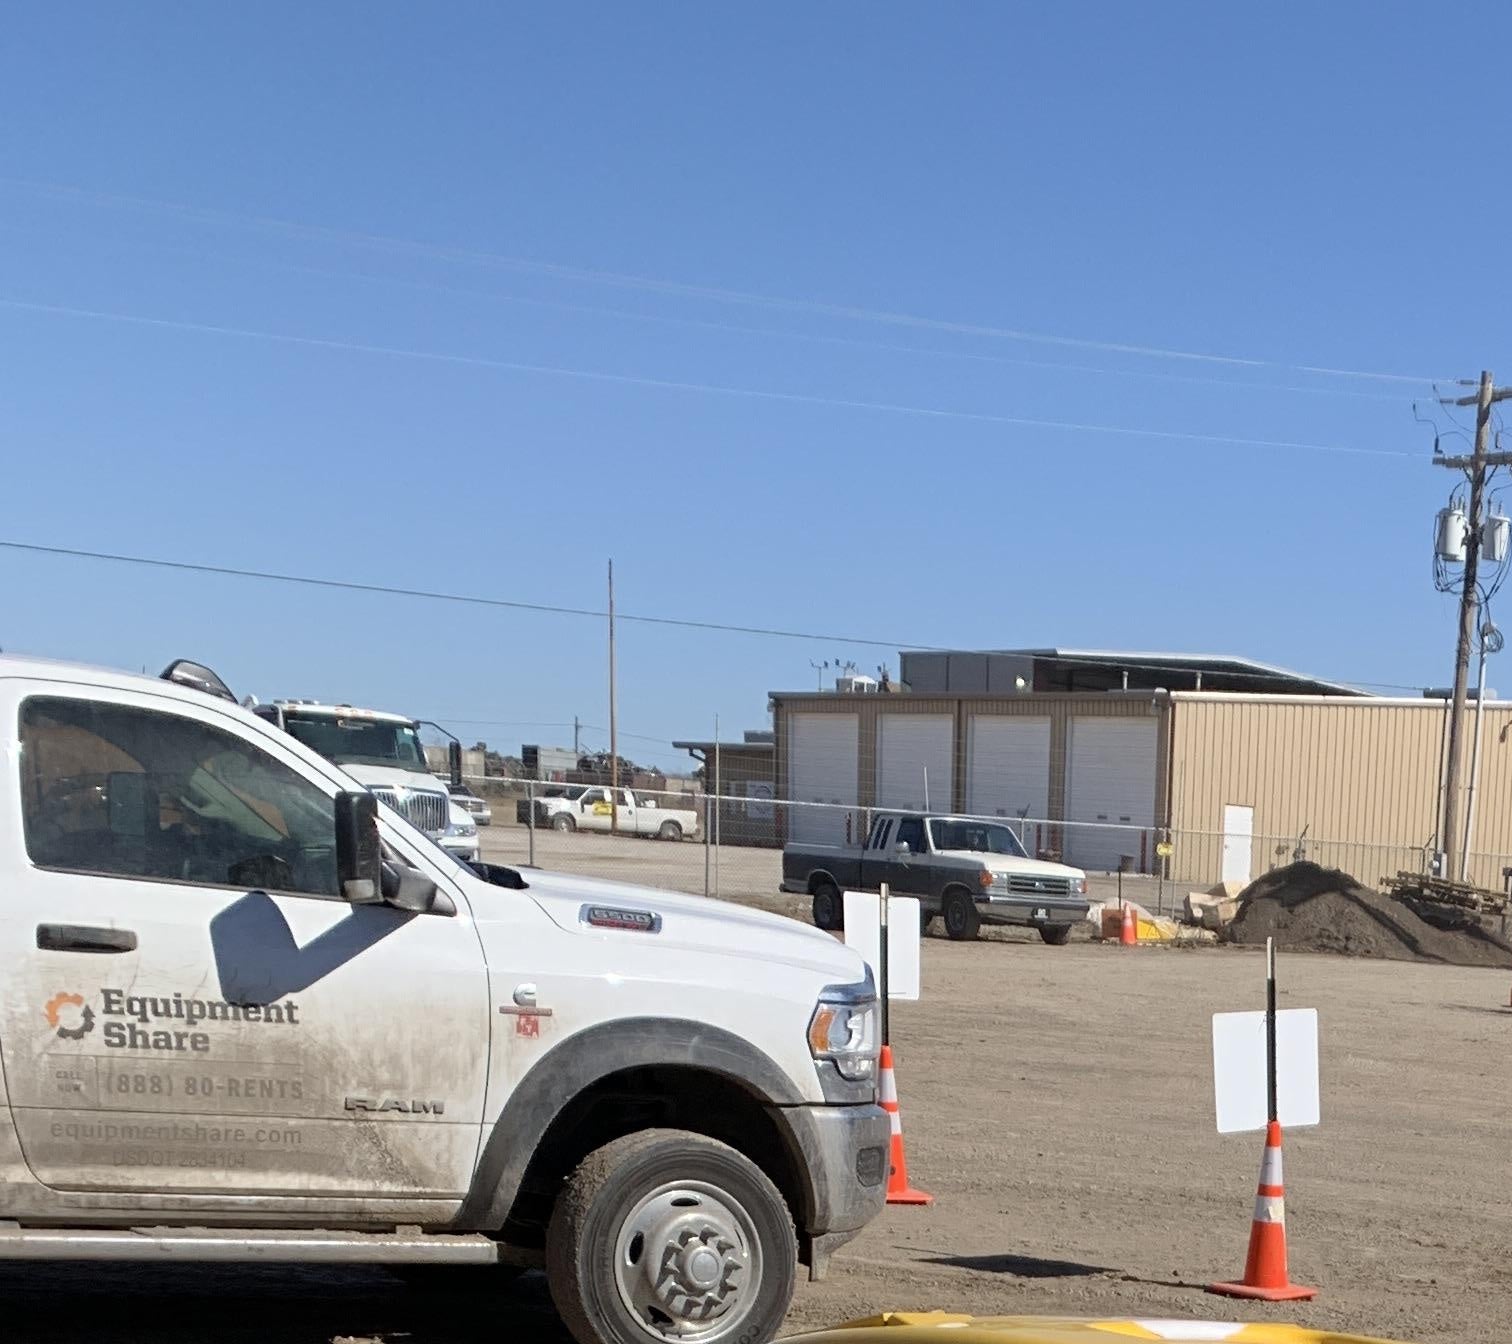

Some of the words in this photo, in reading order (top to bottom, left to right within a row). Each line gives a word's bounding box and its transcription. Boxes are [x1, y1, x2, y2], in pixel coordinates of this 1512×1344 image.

[101, 988, 300, 1025] Equipment
[103, 1022, 211, 1051] Share
[105, 1074, 174, 1097] (888)
[184, 1077, 305, 1101] 80-RENTS
[344, 1097, 445, 1115] RAM
[50, 1121, 303, 1146] equipmentshare.com
